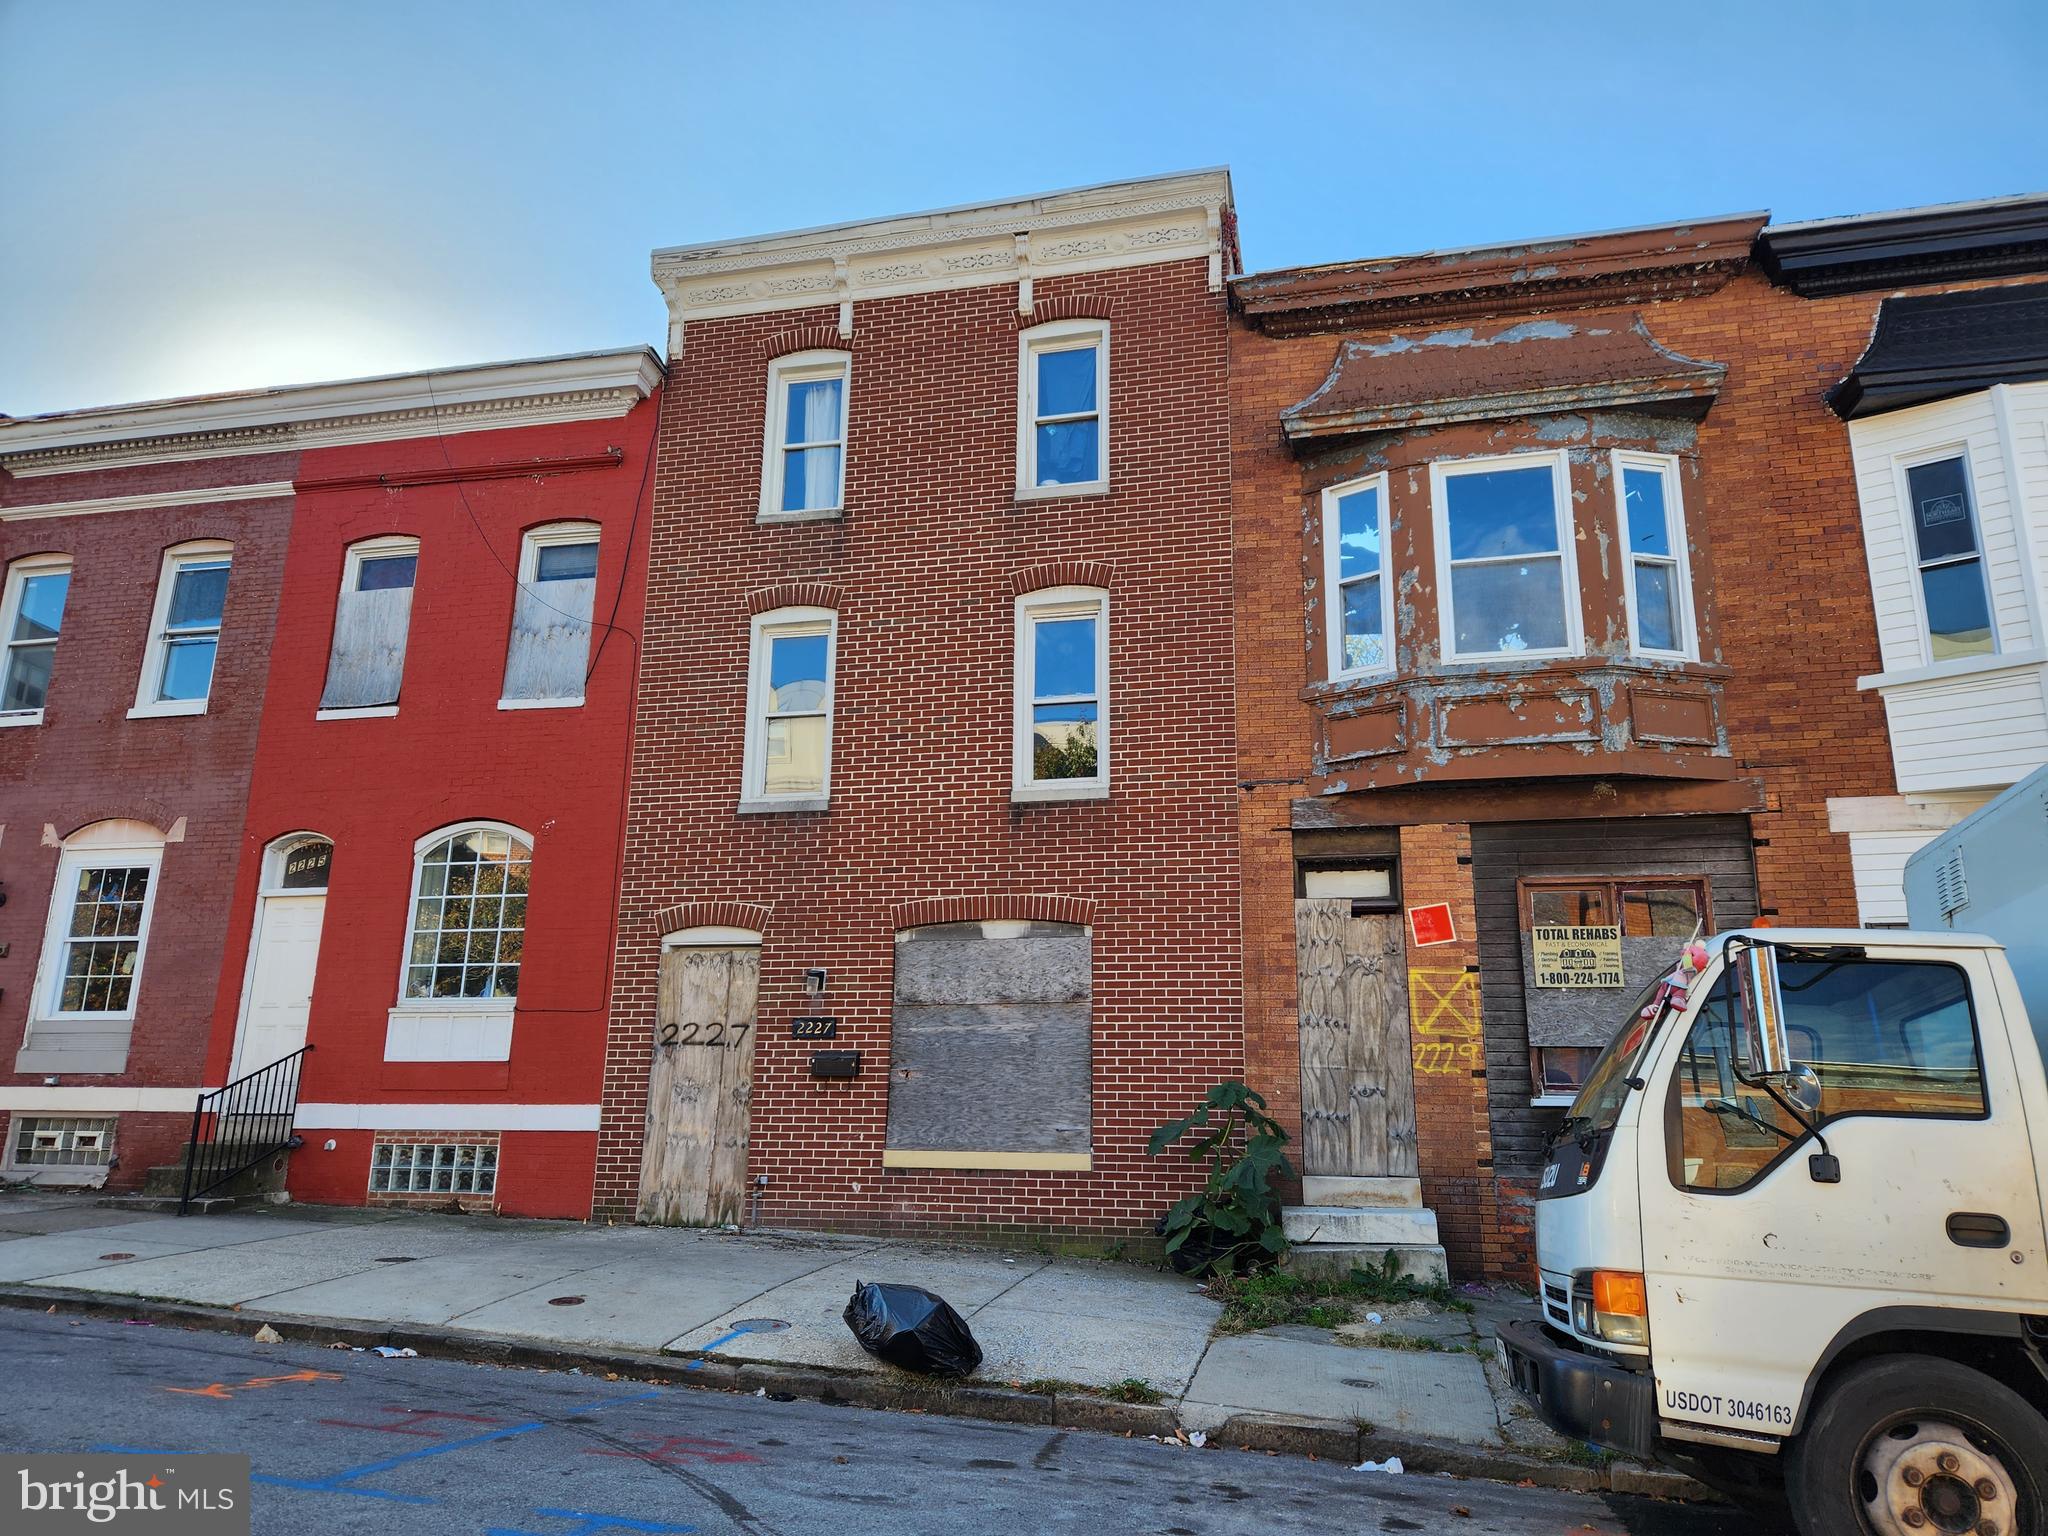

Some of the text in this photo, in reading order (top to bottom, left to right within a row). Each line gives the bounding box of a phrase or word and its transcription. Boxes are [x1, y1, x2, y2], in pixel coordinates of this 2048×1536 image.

[288, 855, 327, 875] 2225
[1535, 928, 1617, 940] TOTAL REHABS
[1540, 972, 1620, 985] 1-800-224-1774
[660, 1022, 750, 1049] 2227
[796, 1021, 832, 1035] 2227
[1414, 1042, 1479, 1074] 2229
[1666, 1389, 1792, 1425] USDOT 3046163
